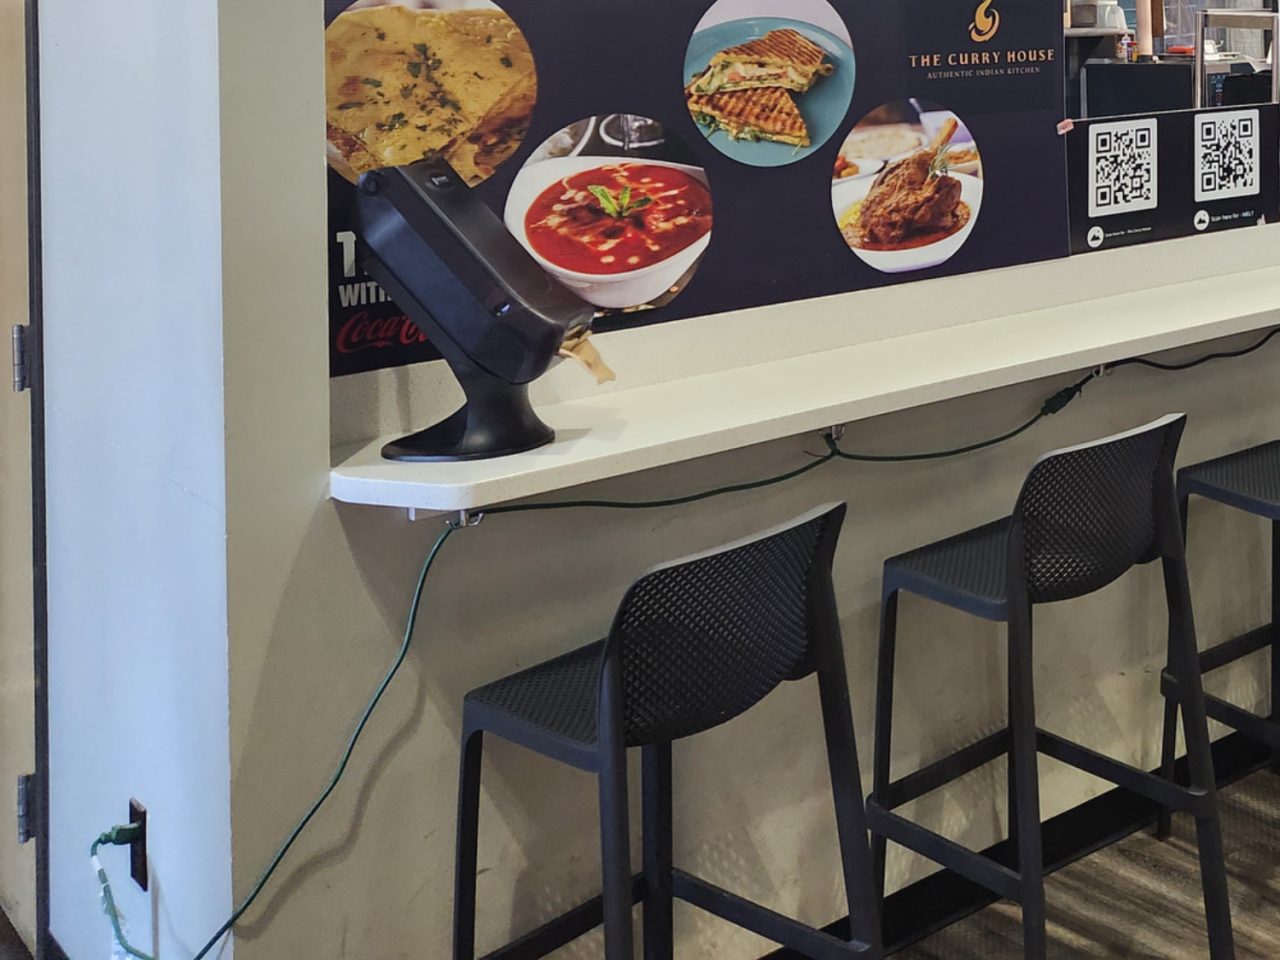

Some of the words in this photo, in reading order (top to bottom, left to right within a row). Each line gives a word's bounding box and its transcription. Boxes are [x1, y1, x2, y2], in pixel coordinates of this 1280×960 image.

[908, 54, 941, 68] THE
[948, 51, 1001, 66] CURRY
[1006, 49, 1055, 62] HOUSE
[927, 69, 974, 79] AUTHENTIC
[976, 67, 1005, 76] INDIAN
[1007, 66, 1040, 75] KITCHEN
